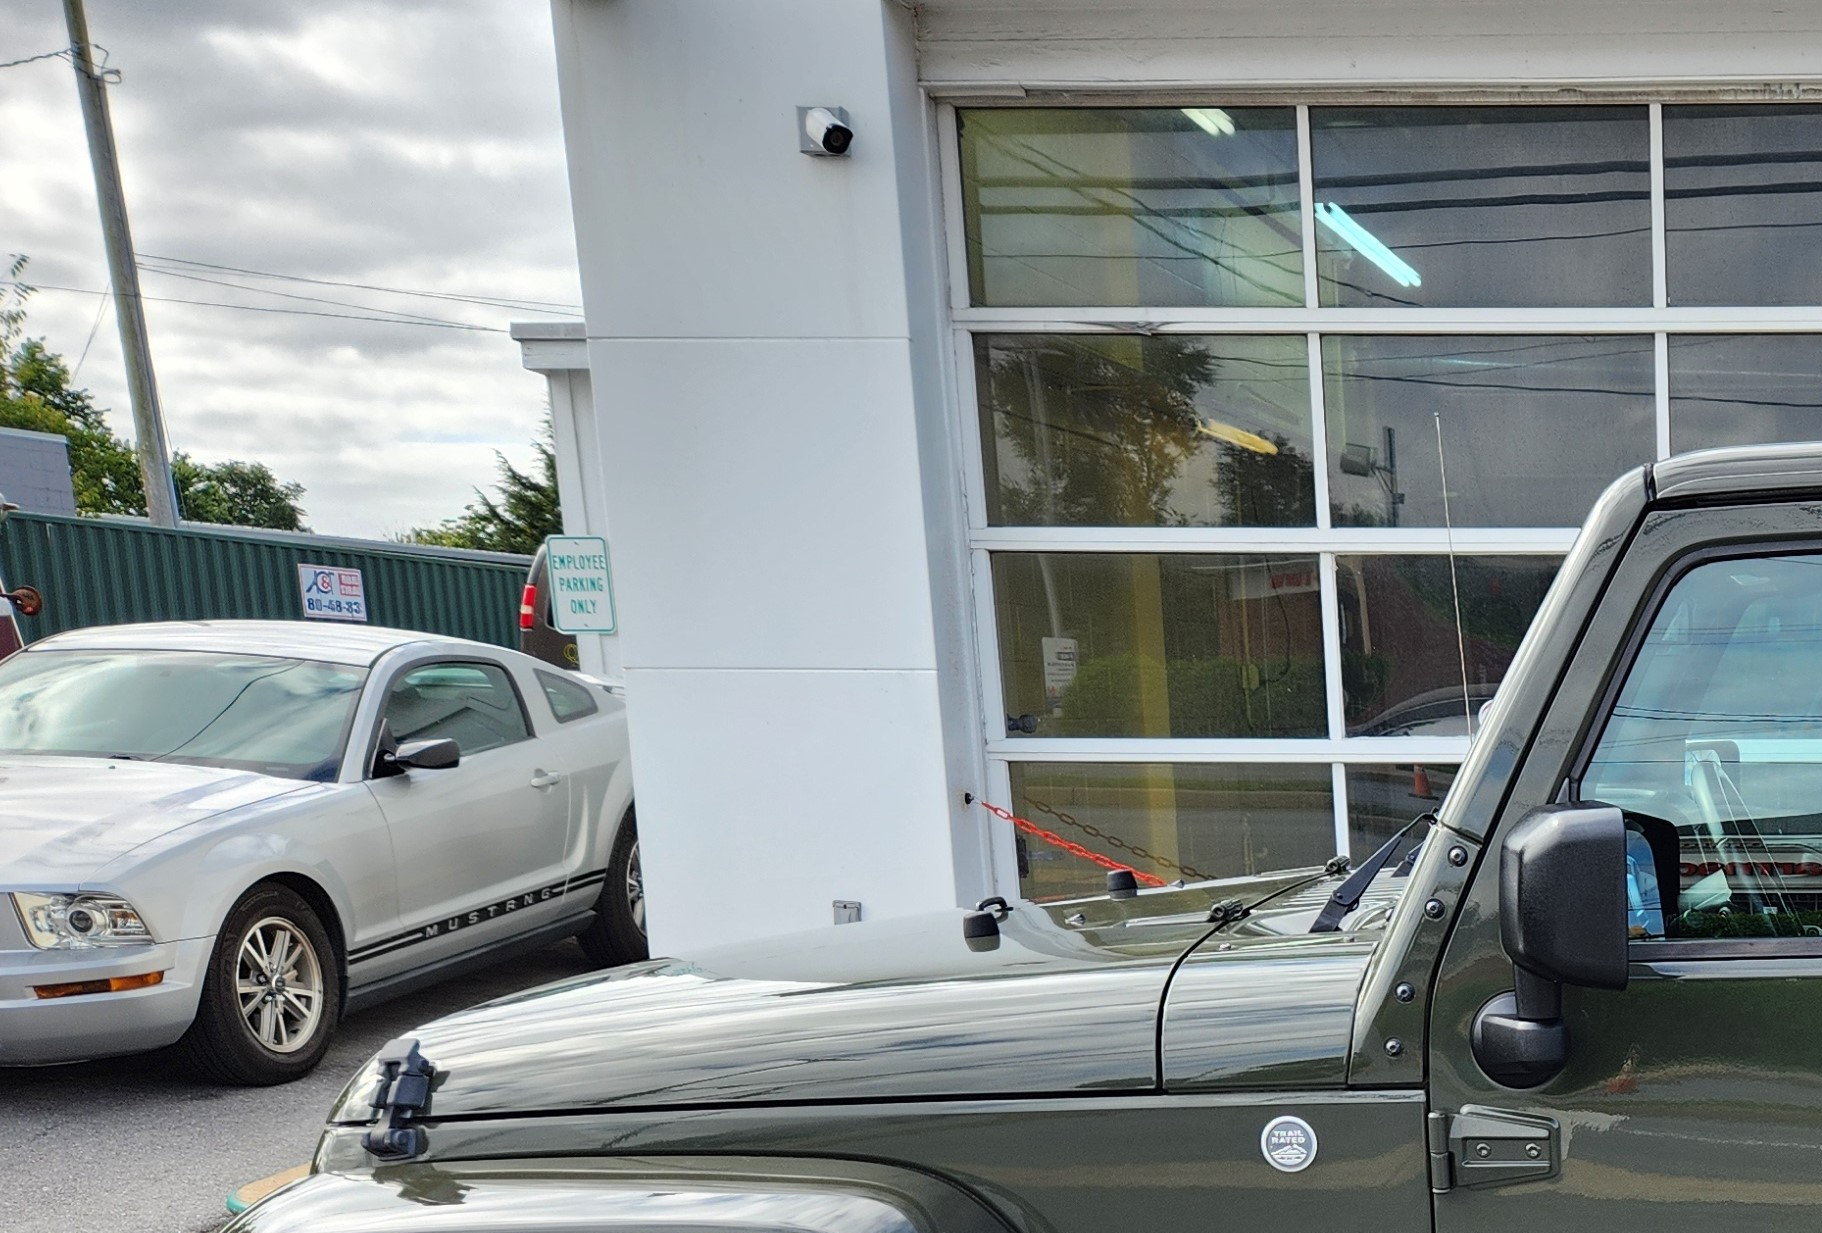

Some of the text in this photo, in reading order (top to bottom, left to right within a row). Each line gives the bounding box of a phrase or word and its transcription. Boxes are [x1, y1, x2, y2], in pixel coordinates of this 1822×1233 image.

[552, 555, 606, 570] EMPLOYEE
[560, 577, 603, 592] PARKING
[570, 599, 597, 614] ONLY
[425, 888, 551, 938] MUSTANG
[1271, 1136, 1306, 1144] RATED
